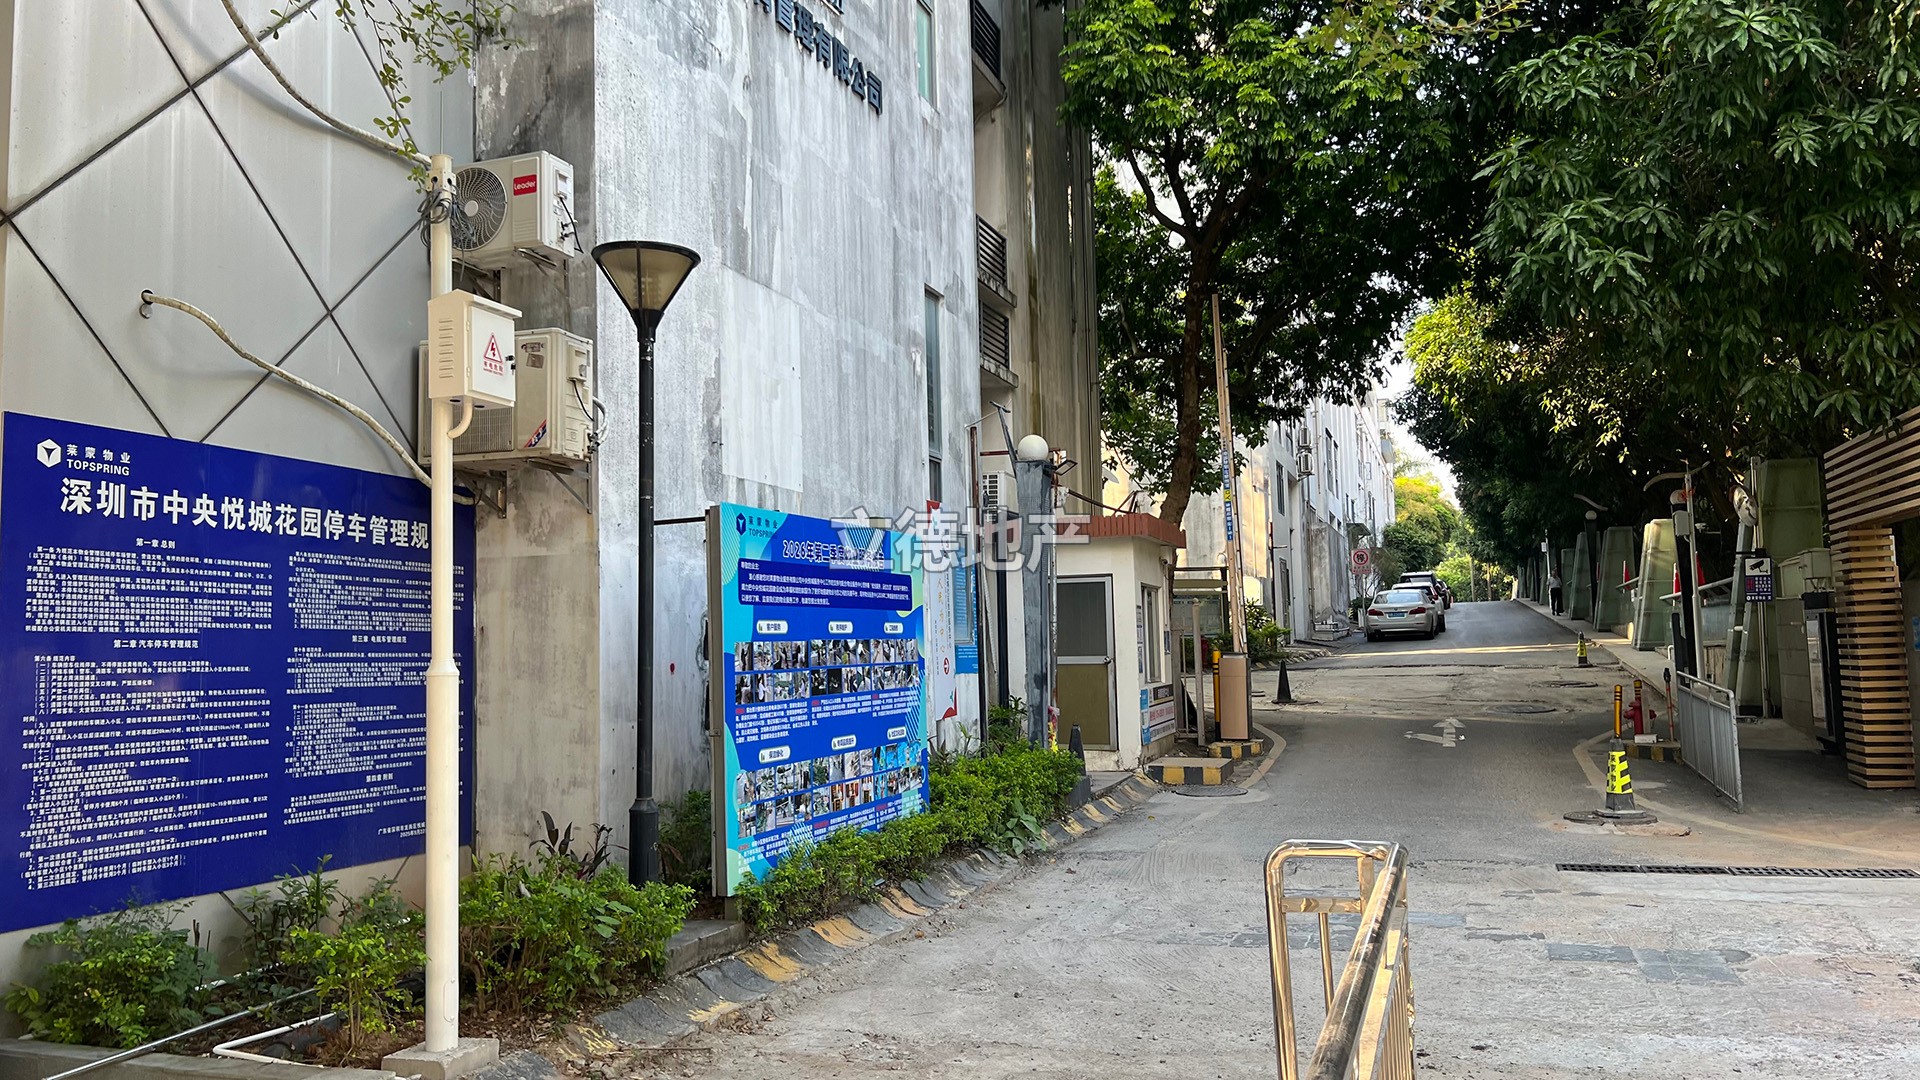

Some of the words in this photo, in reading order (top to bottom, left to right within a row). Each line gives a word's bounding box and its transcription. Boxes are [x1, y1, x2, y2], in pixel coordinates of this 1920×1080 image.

[513, 181, 536, 190] Leader
[66, 444, 131, 464] 莱蒙物业
[66, 459, 130, 476] TOPSPRING
[60, 477, 430, 549] 深圳市中央悦城花园停车管理规
[113, 639, 137, 648] 第二章
[138, 639, 198, 648] 汽车停车管理规范
